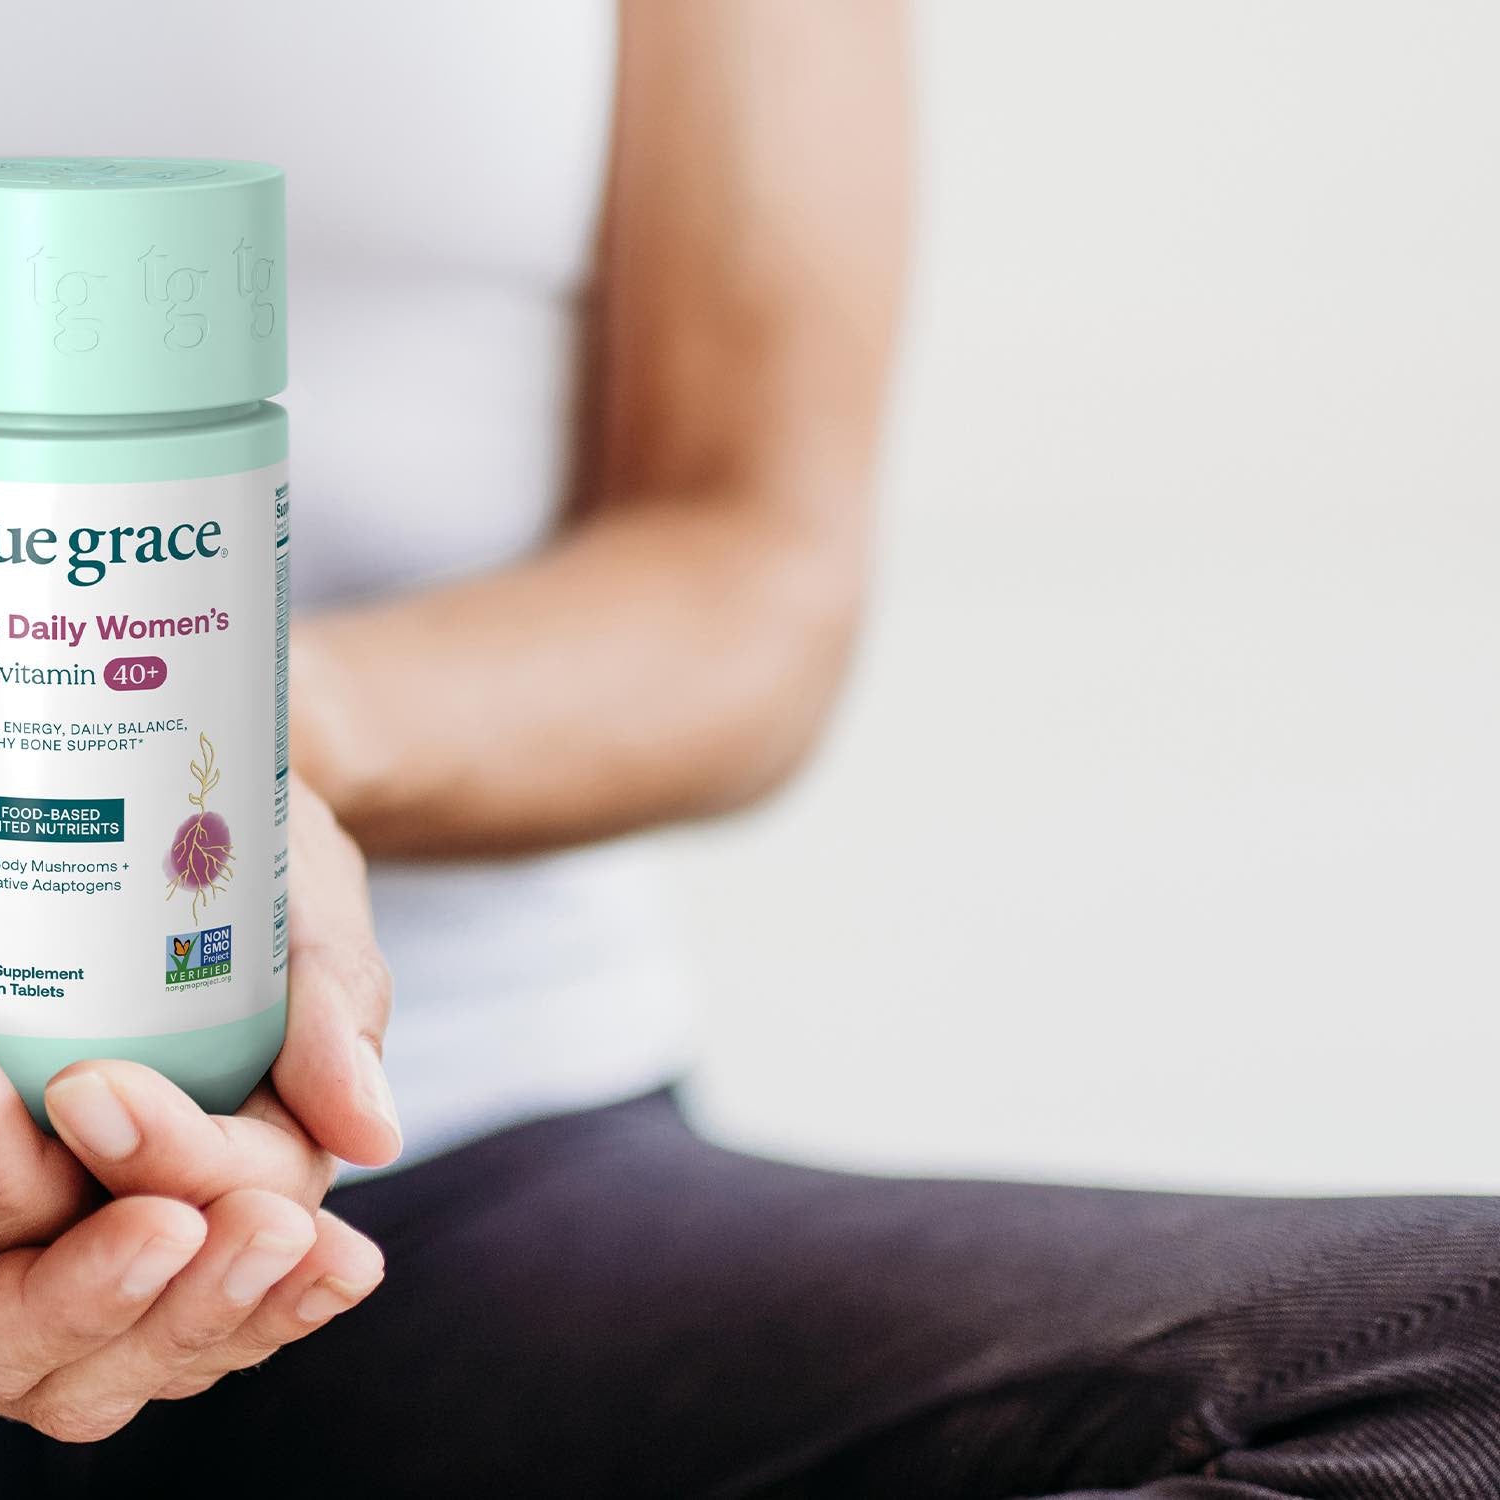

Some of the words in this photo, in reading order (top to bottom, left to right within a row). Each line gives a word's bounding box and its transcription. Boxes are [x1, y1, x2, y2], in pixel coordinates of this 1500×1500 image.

[8, 613, 88, 648] Daily
[96, 607, 230, 641] Women's
[112, 663, 160, 686] 40+
[3, 721, 66, 737] ENERGY,
[71, 723, 113, 736] DAILY
[118, 718, 188, 735] BALANCE,
[20, 738, 62, 751] BONE
[1, 806, 101, 822] FOOD-BASED
[35, 822, 120, 836] NUTRIENTS
[31, 859, 118, 874] Mushrooms
[122, 862, 130, 871] +
[32, 879, 122, 895] Adaptogens
[204, 929, 229, 944] NON
[203, 940, 230, 955] GMO
[203, 952, 229, 964] Project
[169, 963, 229, 982] VERIFIED
[9, 983, 65, 998] Tablets
